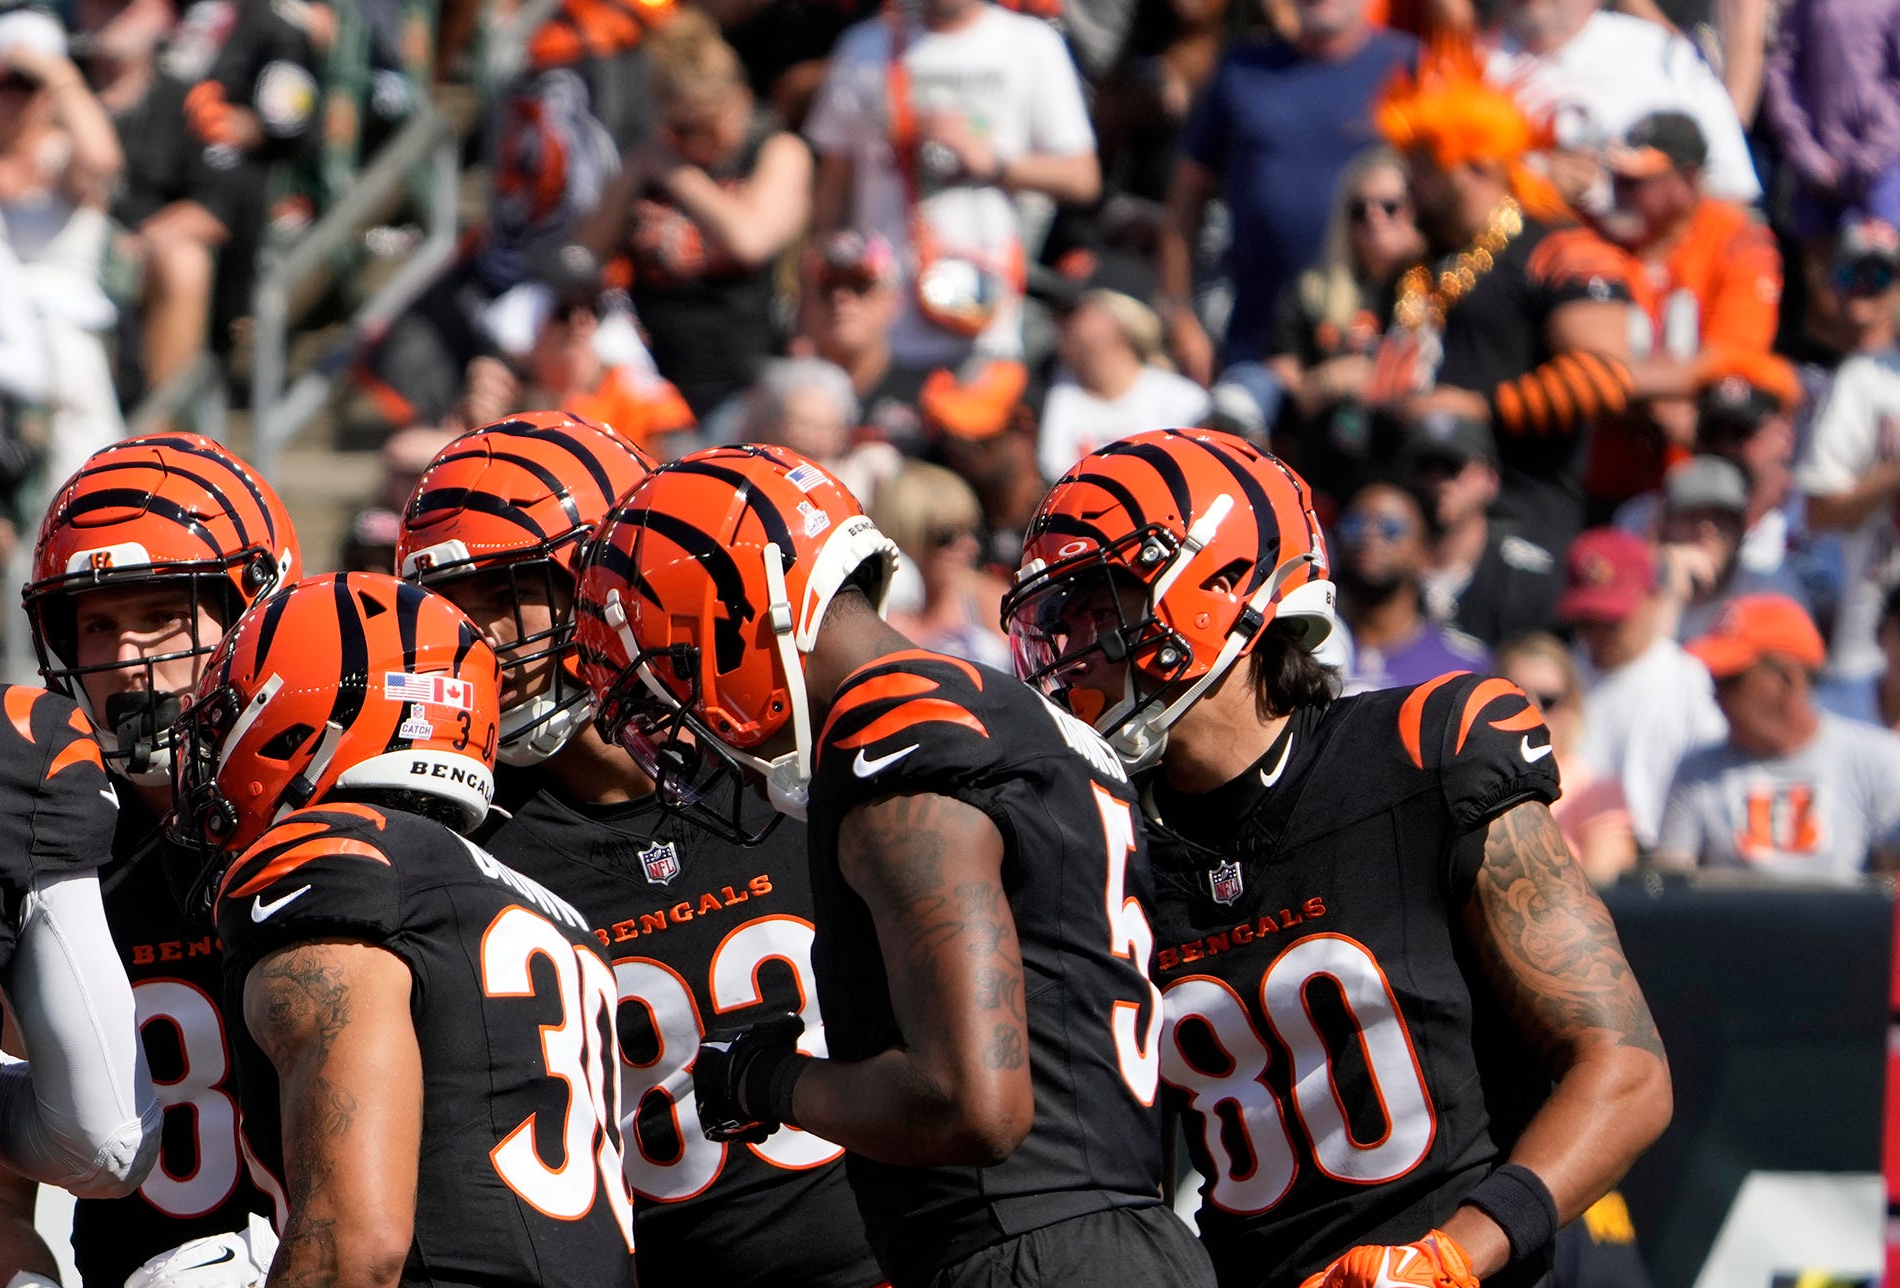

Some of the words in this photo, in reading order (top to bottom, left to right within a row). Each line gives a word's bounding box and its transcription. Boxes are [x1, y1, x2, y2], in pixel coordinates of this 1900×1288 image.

[1090, 779, 1164, 1107] 5
[1157, 895, 1328, 971] BENGALS
[1159, 931, 1437, 1216] 80
[131, 975, 293, 1240] 8
[480, 903, 635, 1254] 30
